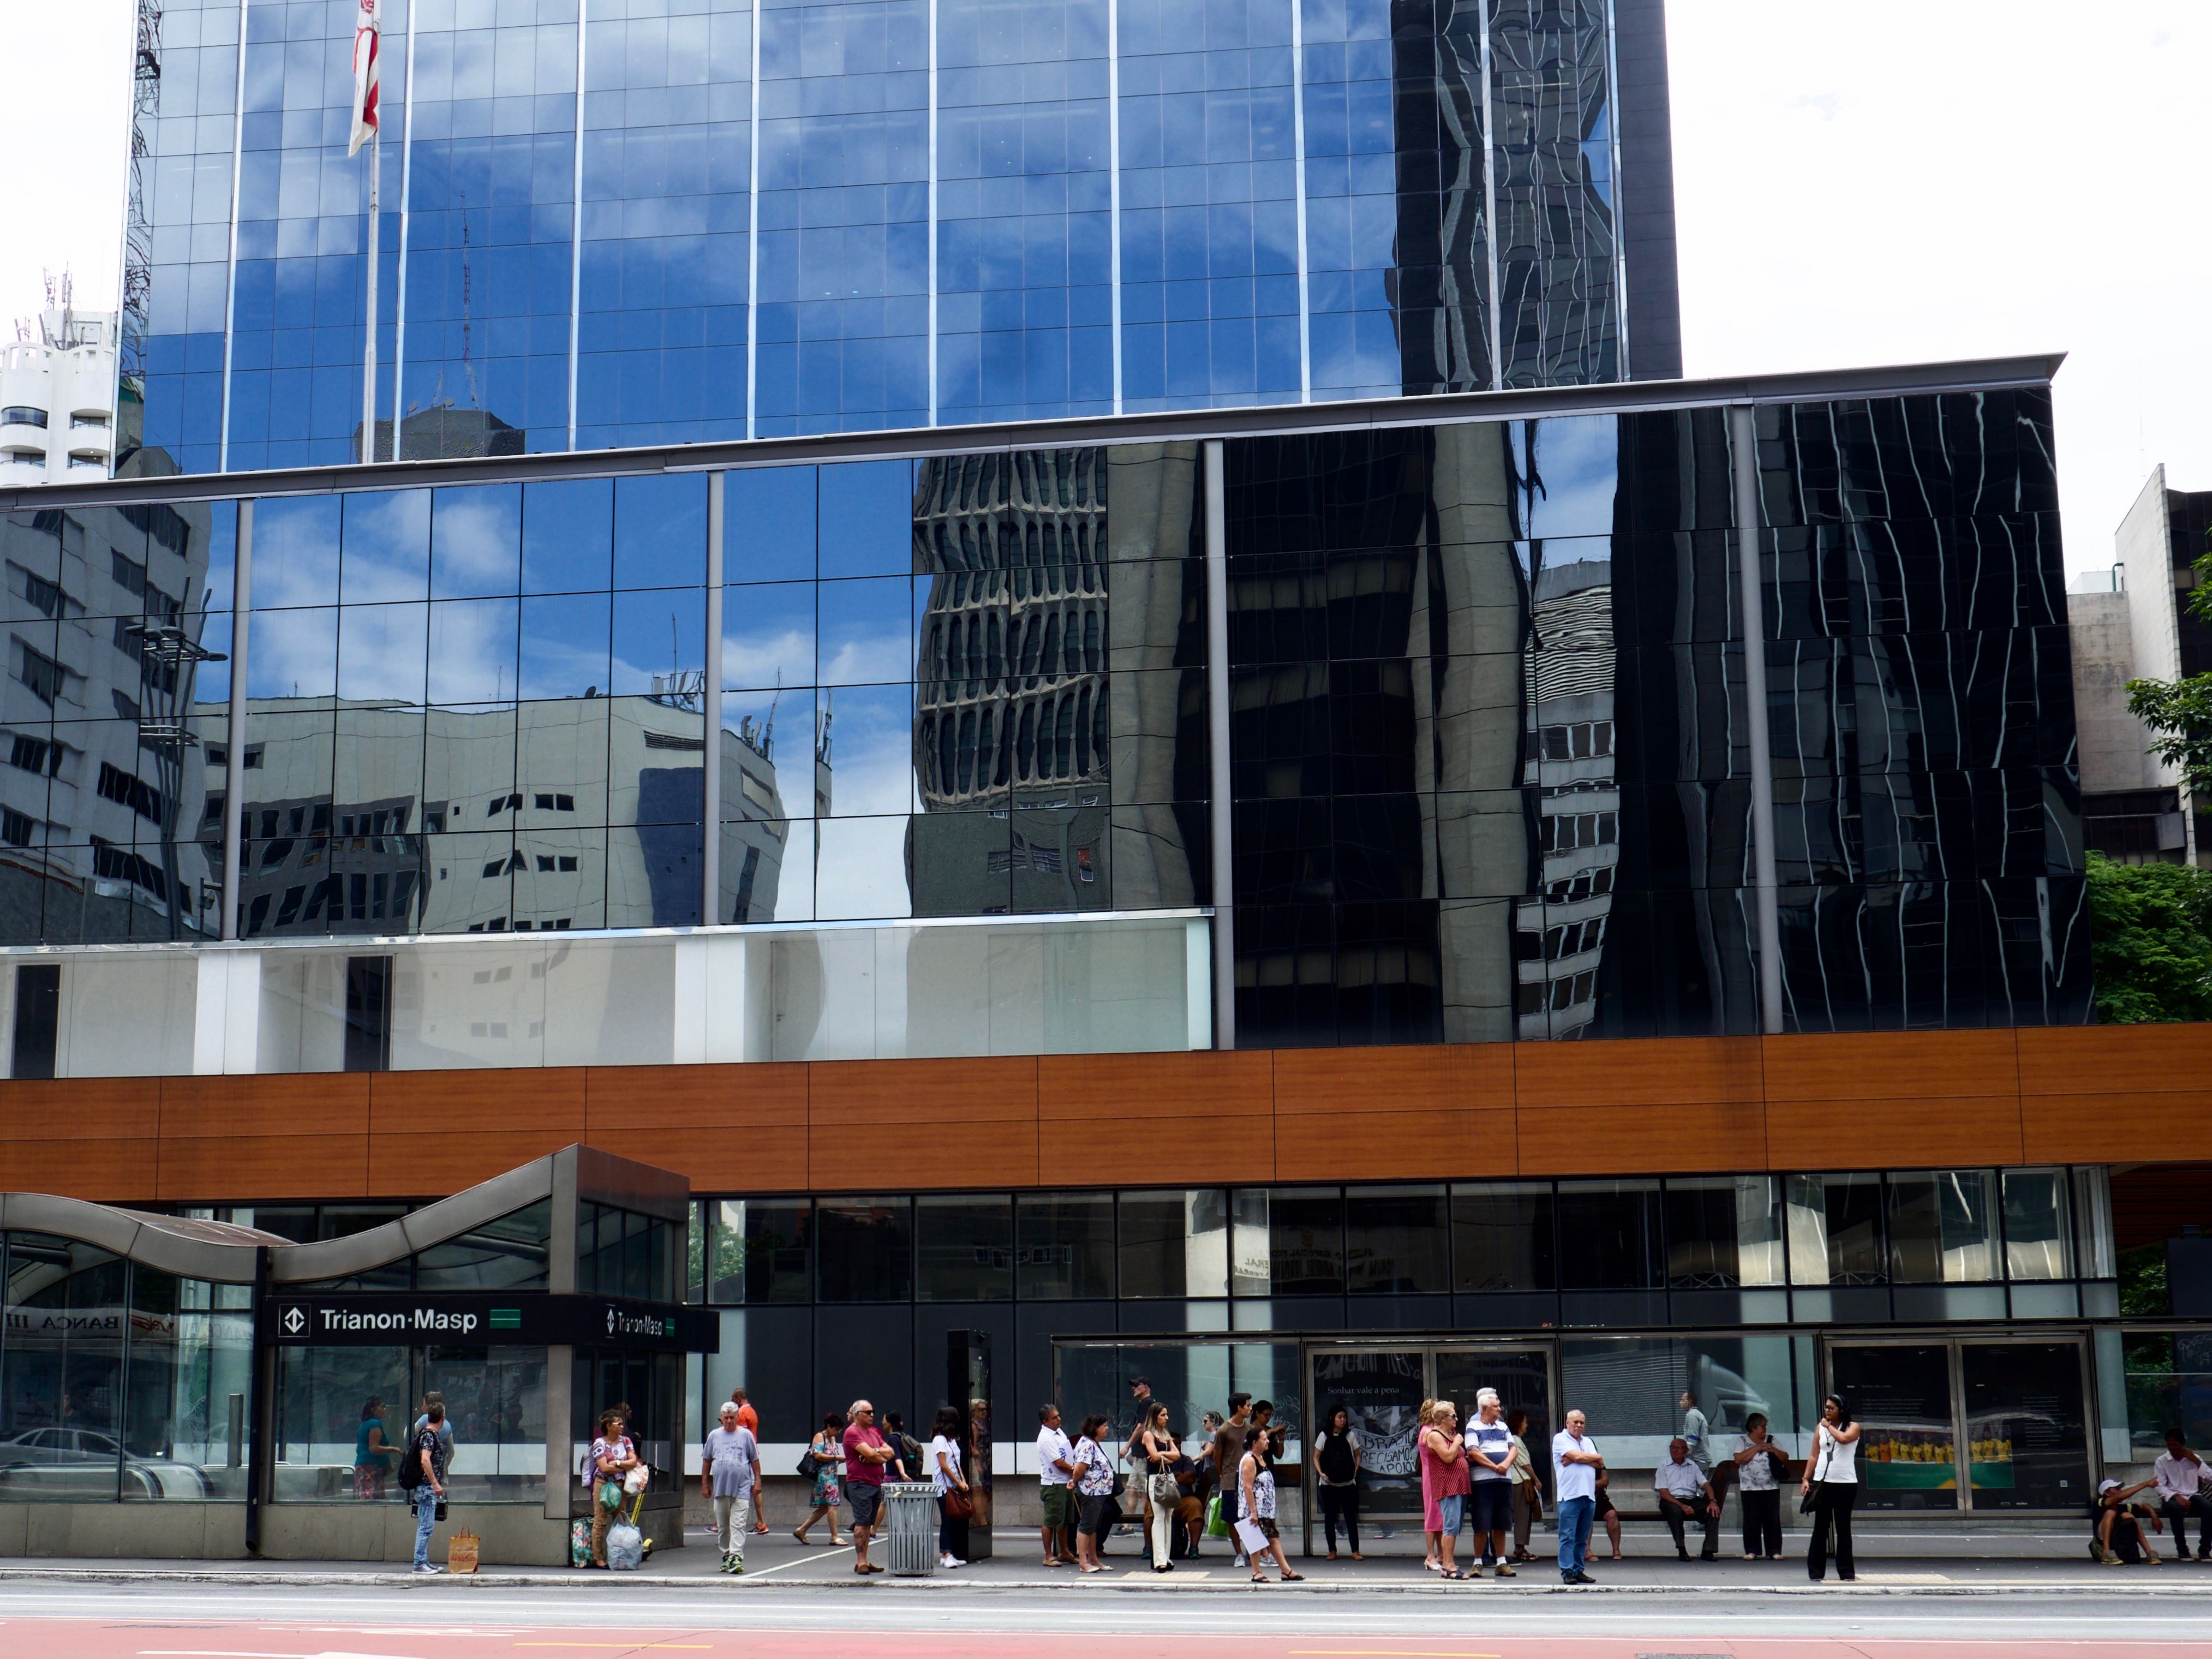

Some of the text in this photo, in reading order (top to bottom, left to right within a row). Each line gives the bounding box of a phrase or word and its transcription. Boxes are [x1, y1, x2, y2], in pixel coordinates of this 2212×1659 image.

[1327, 1386, 1354, 1394] Sonhar
[1381, 1387, 1400, 1396] pena
[1361, 1431, 1412, 1449] BRASIL
